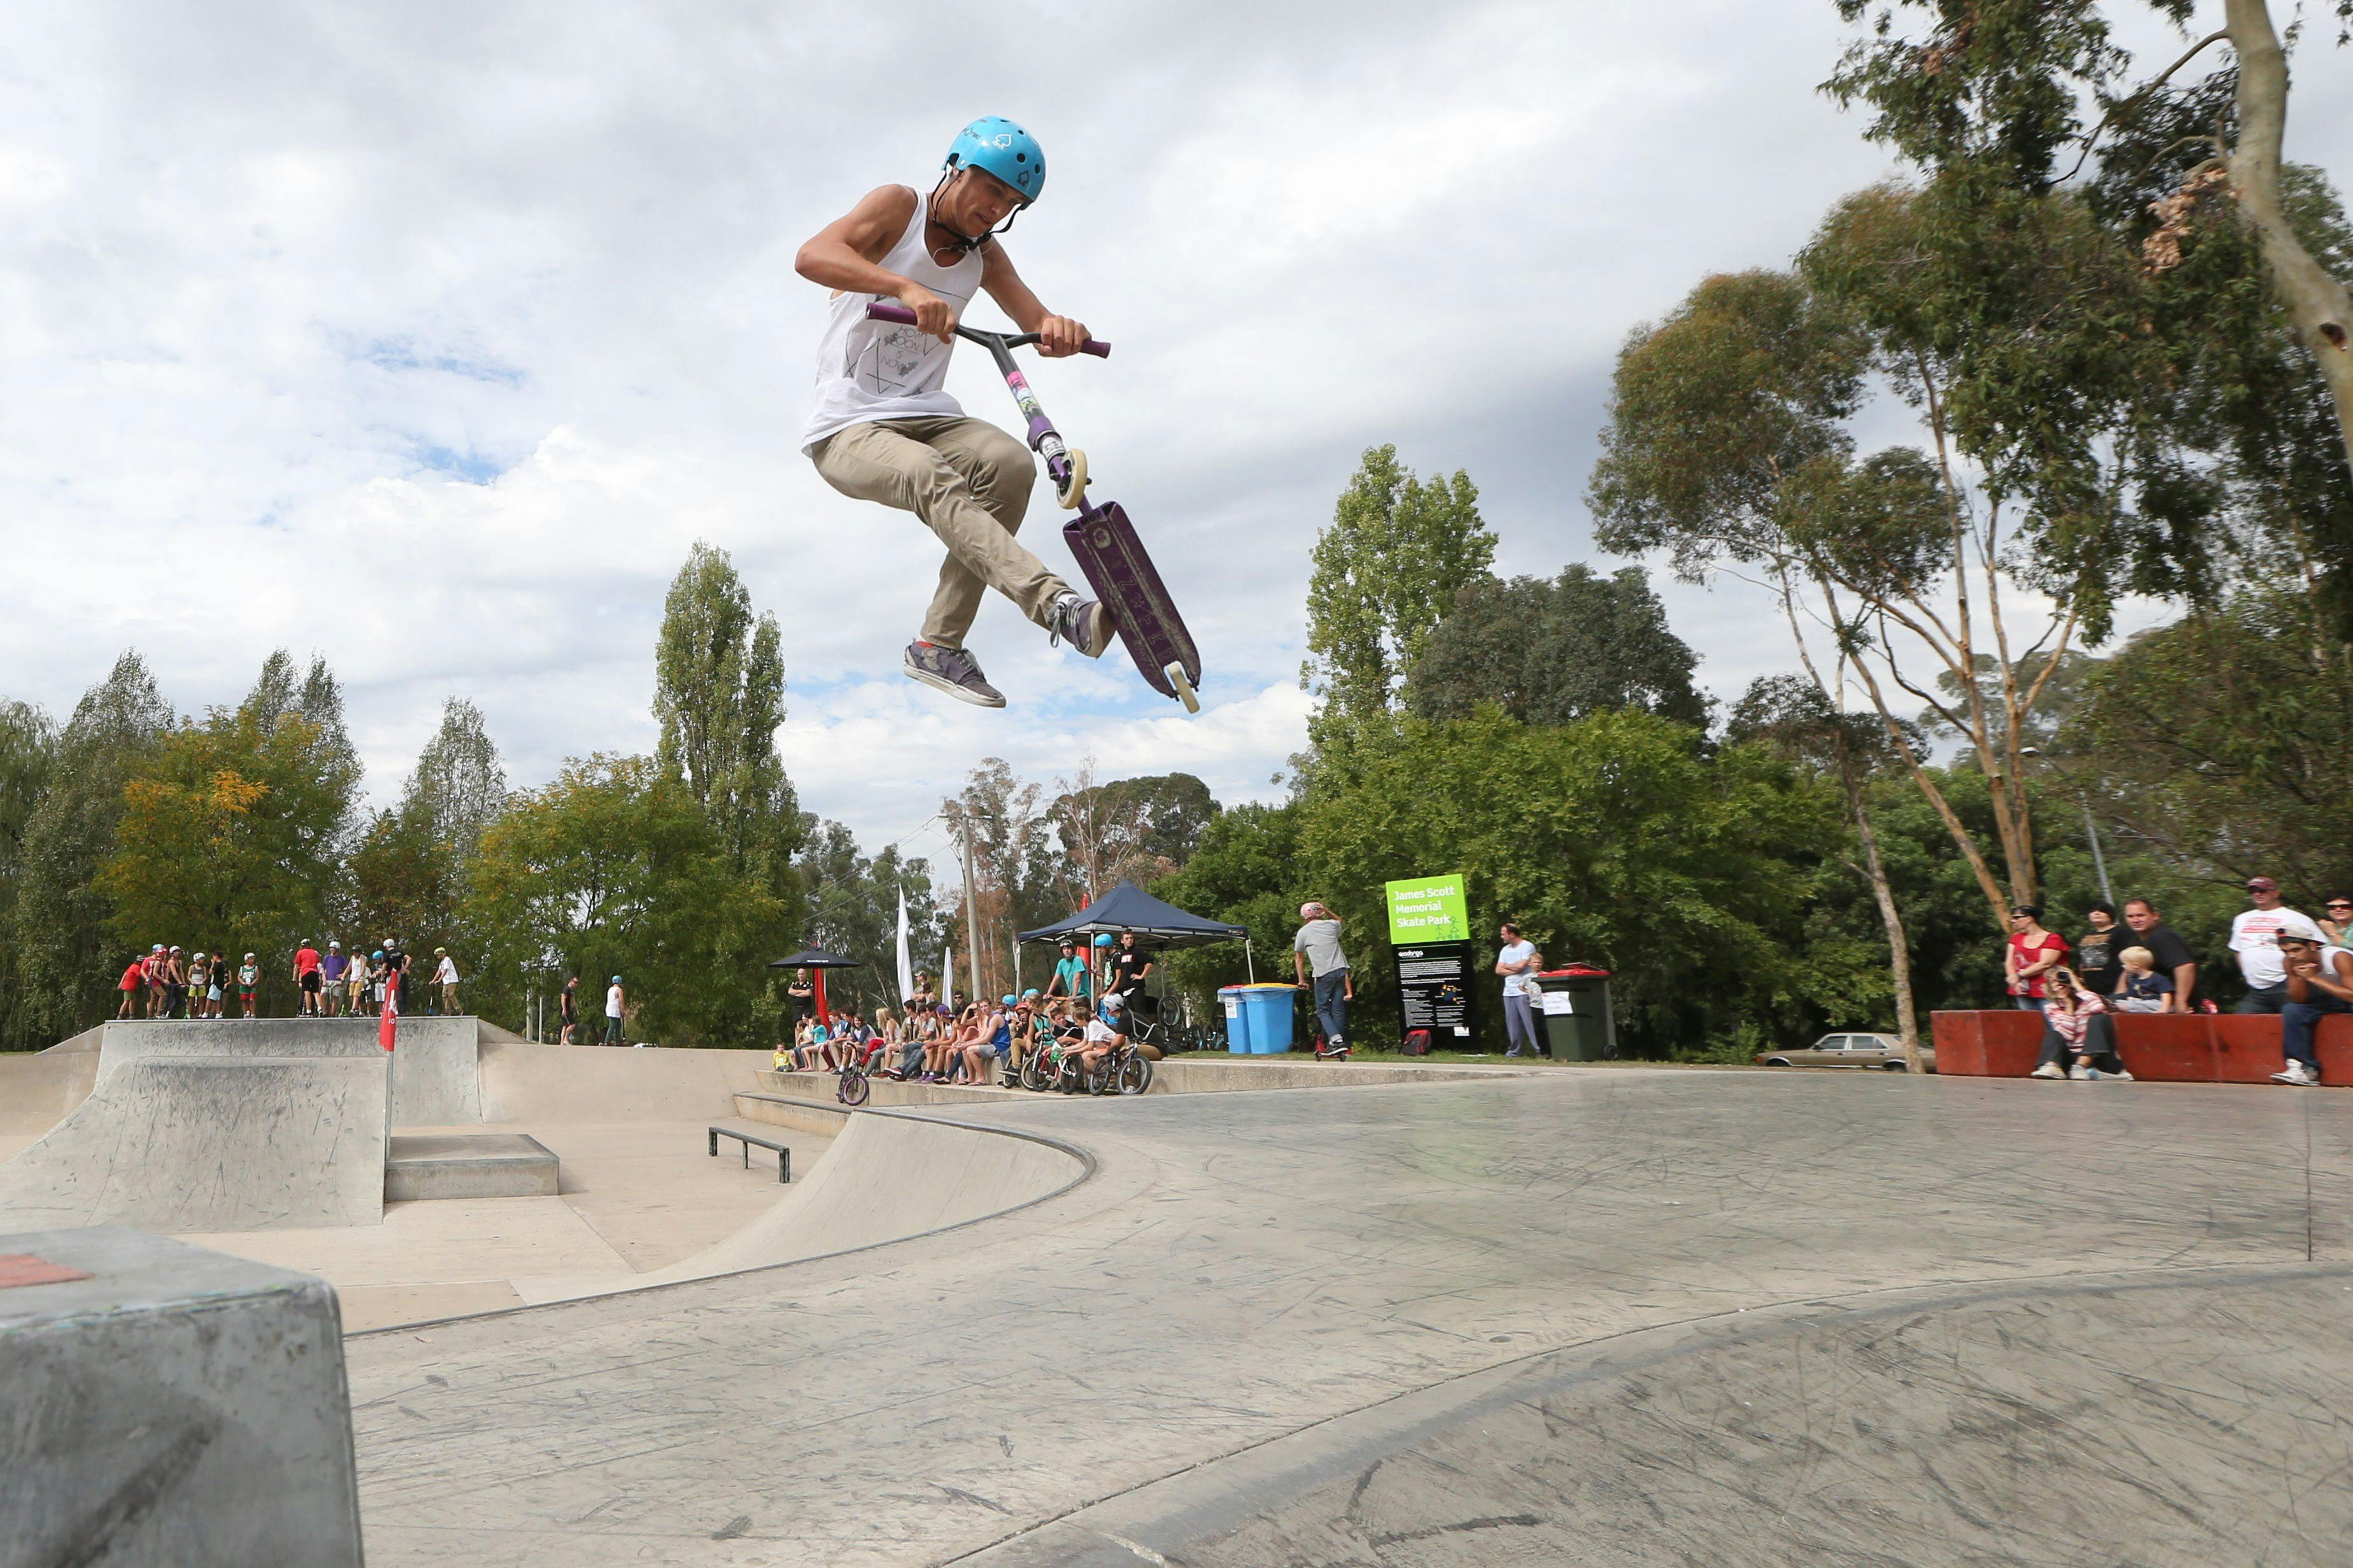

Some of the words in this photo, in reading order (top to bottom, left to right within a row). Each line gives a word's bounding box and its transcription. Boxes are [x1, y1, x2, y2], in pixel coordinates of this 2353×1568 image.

[891, 332, 920, 351] SOON
[1395, 890, 1425, 901] James
[1426, 886, 1456, 898] Scott
[1395, 900, 1442, 914] Memorial
[1397, 917, 1426, 928] Skate
[1427, 914, 1451, 925] Park
